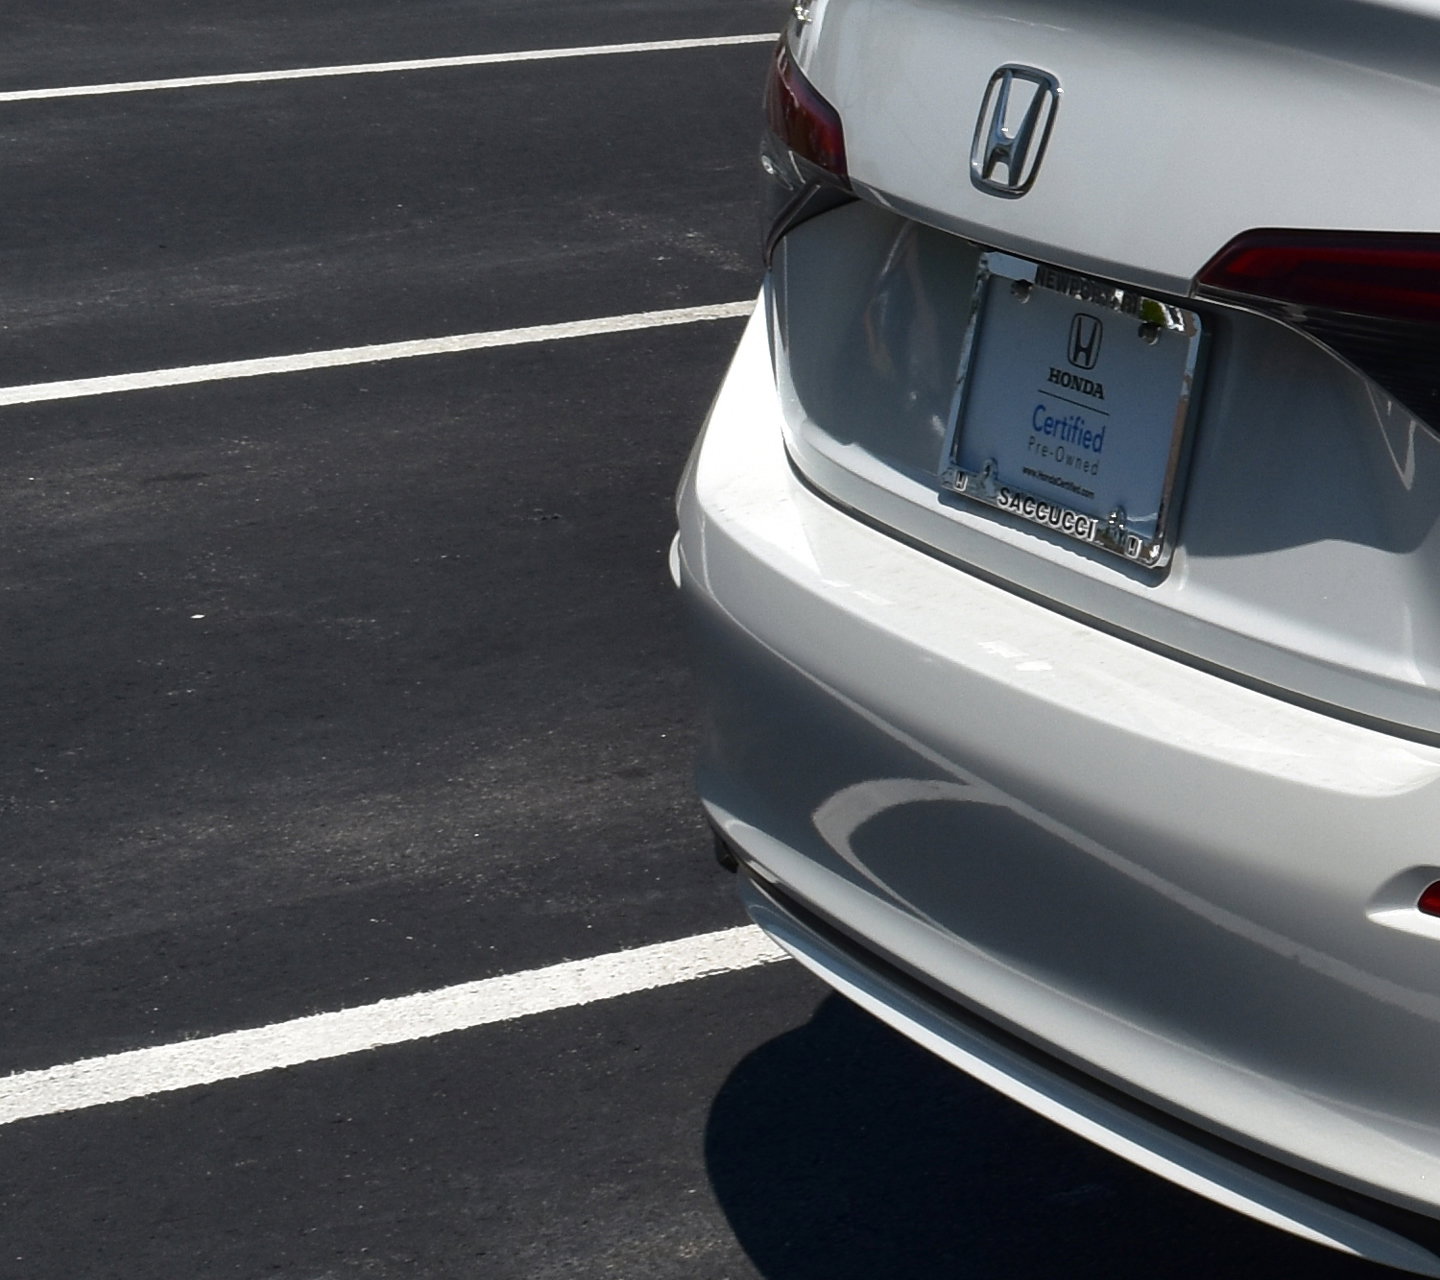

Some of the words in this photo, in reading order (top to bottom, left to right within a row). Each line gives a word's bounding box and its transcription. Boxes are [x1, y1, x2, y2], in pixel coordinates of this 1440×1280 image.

[1047, 367, 1105, 400] HONDA
[1032, 404, 1106, 453] Certified
[1027, 435, 1100, 476] Pre-Owned
[998, 486, 1095, 540] SACCUCCI
